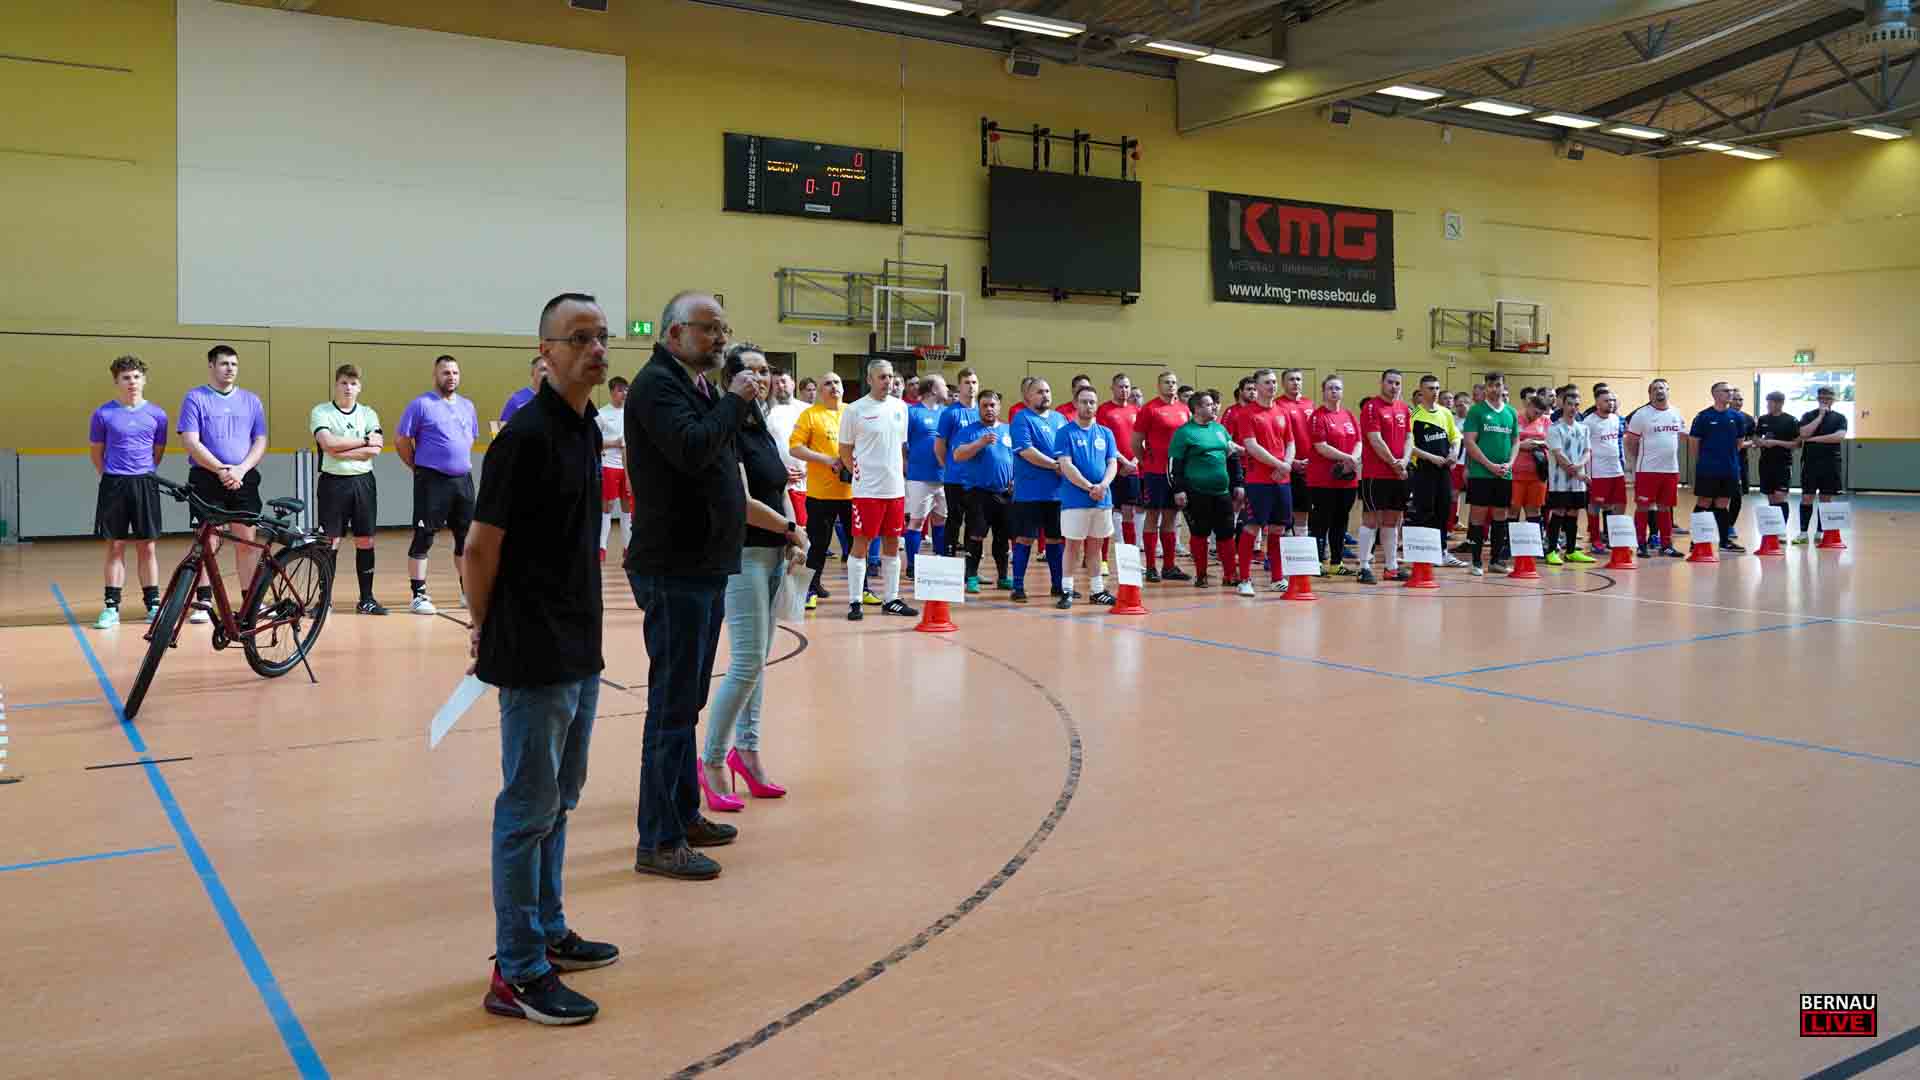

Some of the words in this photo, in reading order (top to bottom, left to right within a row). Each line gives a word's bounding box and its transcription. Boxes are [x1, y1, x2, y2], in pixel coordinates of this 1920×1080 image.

[854, 152, 863, 168] 0
[805, 178, 815, 194] 0
[831, 181, 840, 197] 0
[1228, 282, 1377, 304] www.kmg-messebau.de
